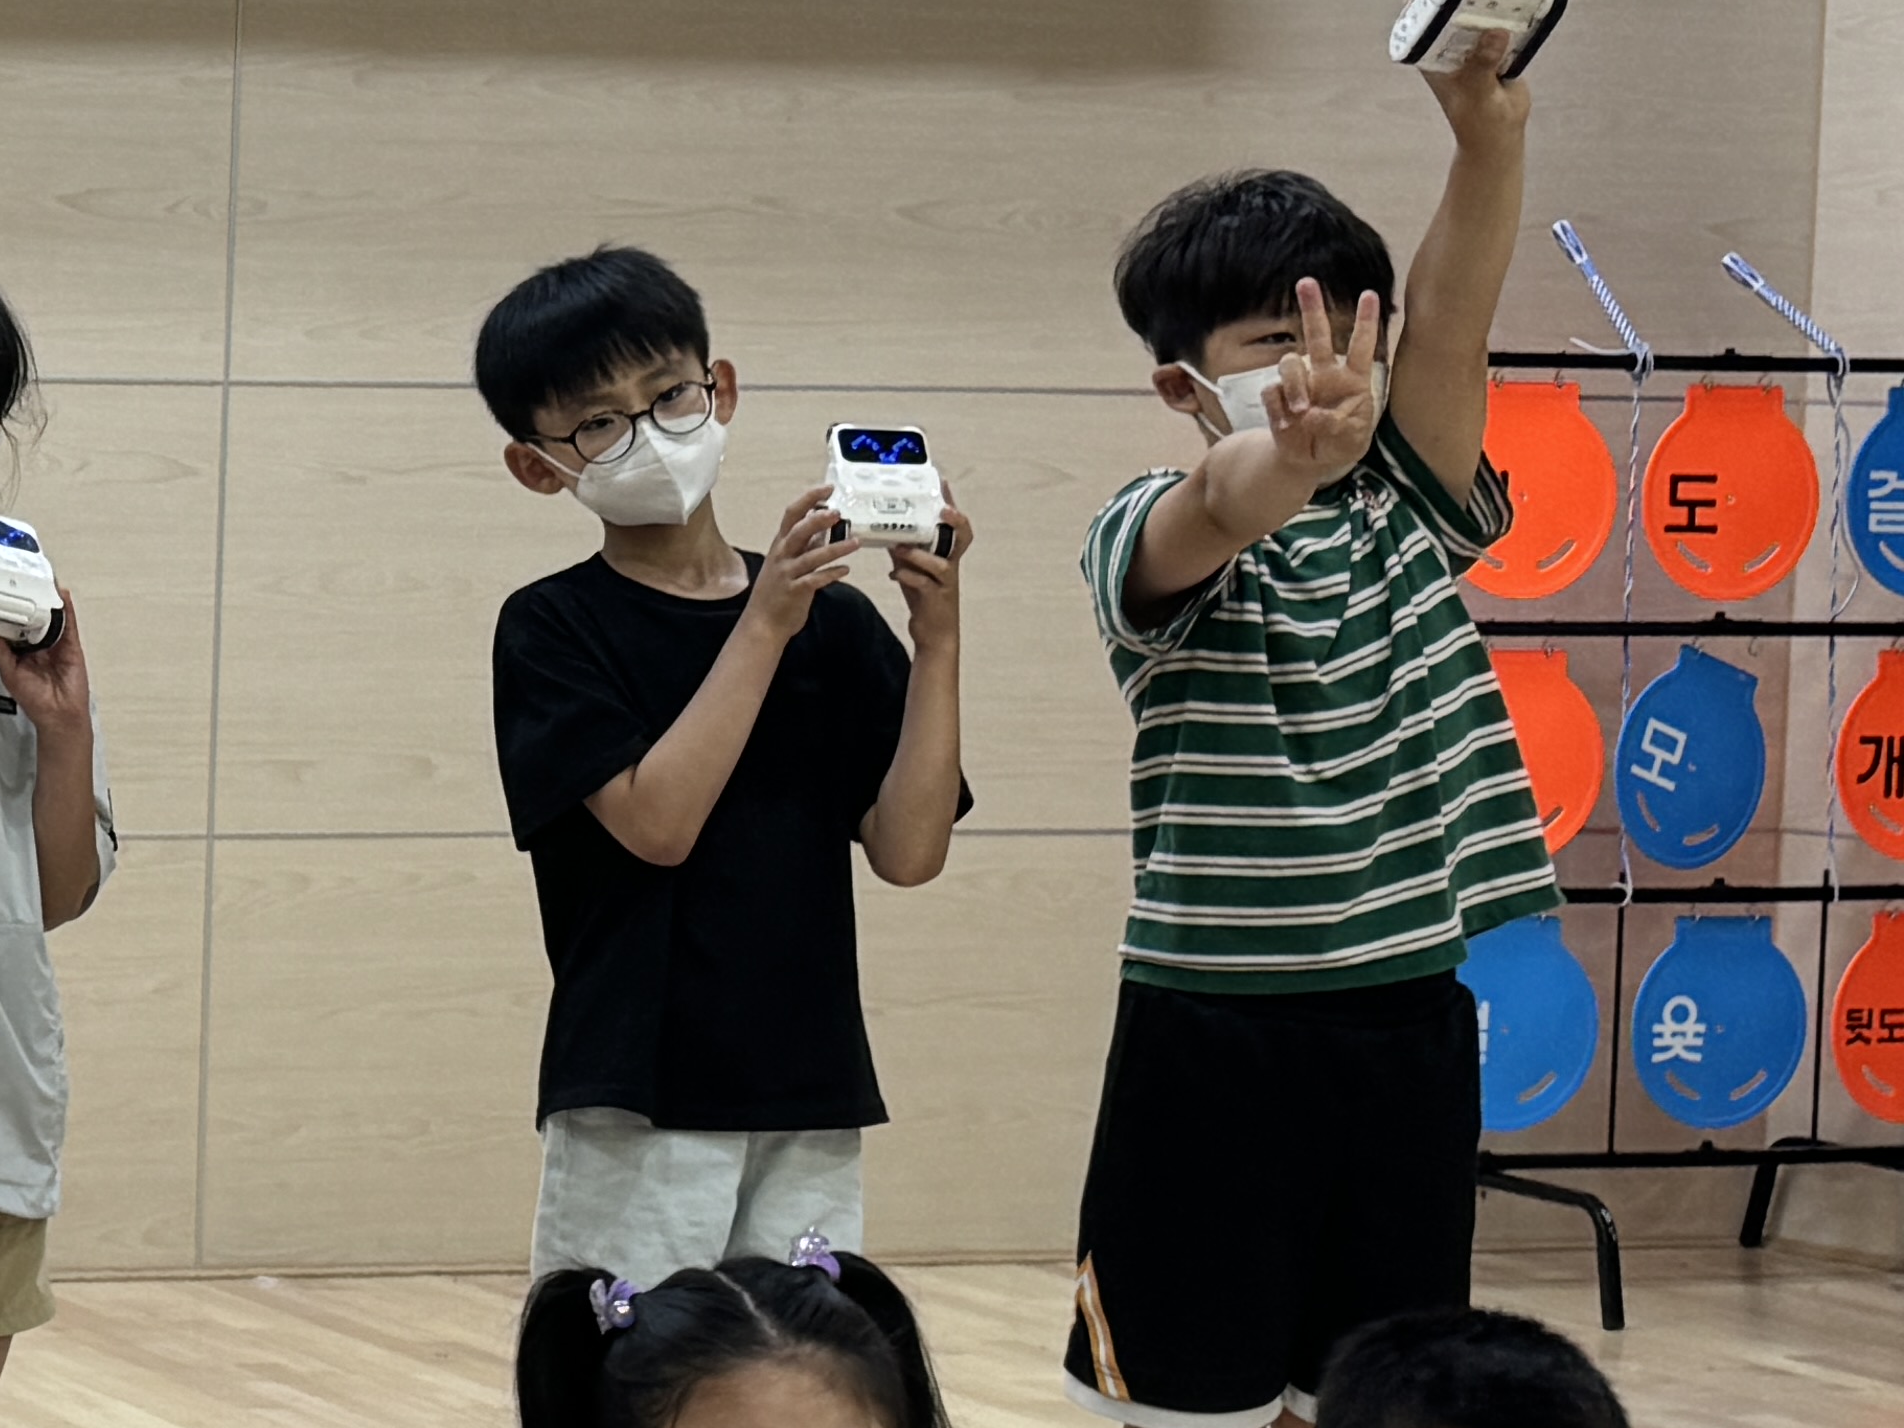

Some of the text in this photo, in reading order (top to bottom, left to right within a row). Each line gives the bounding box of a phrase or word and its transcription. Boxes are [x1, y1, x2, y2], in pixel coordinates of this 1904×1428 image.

[1664, 473, 1718, 534] 도
[1630, 717, 1687, 792] 모
[1651, 994, 1707, 1063] 윷
